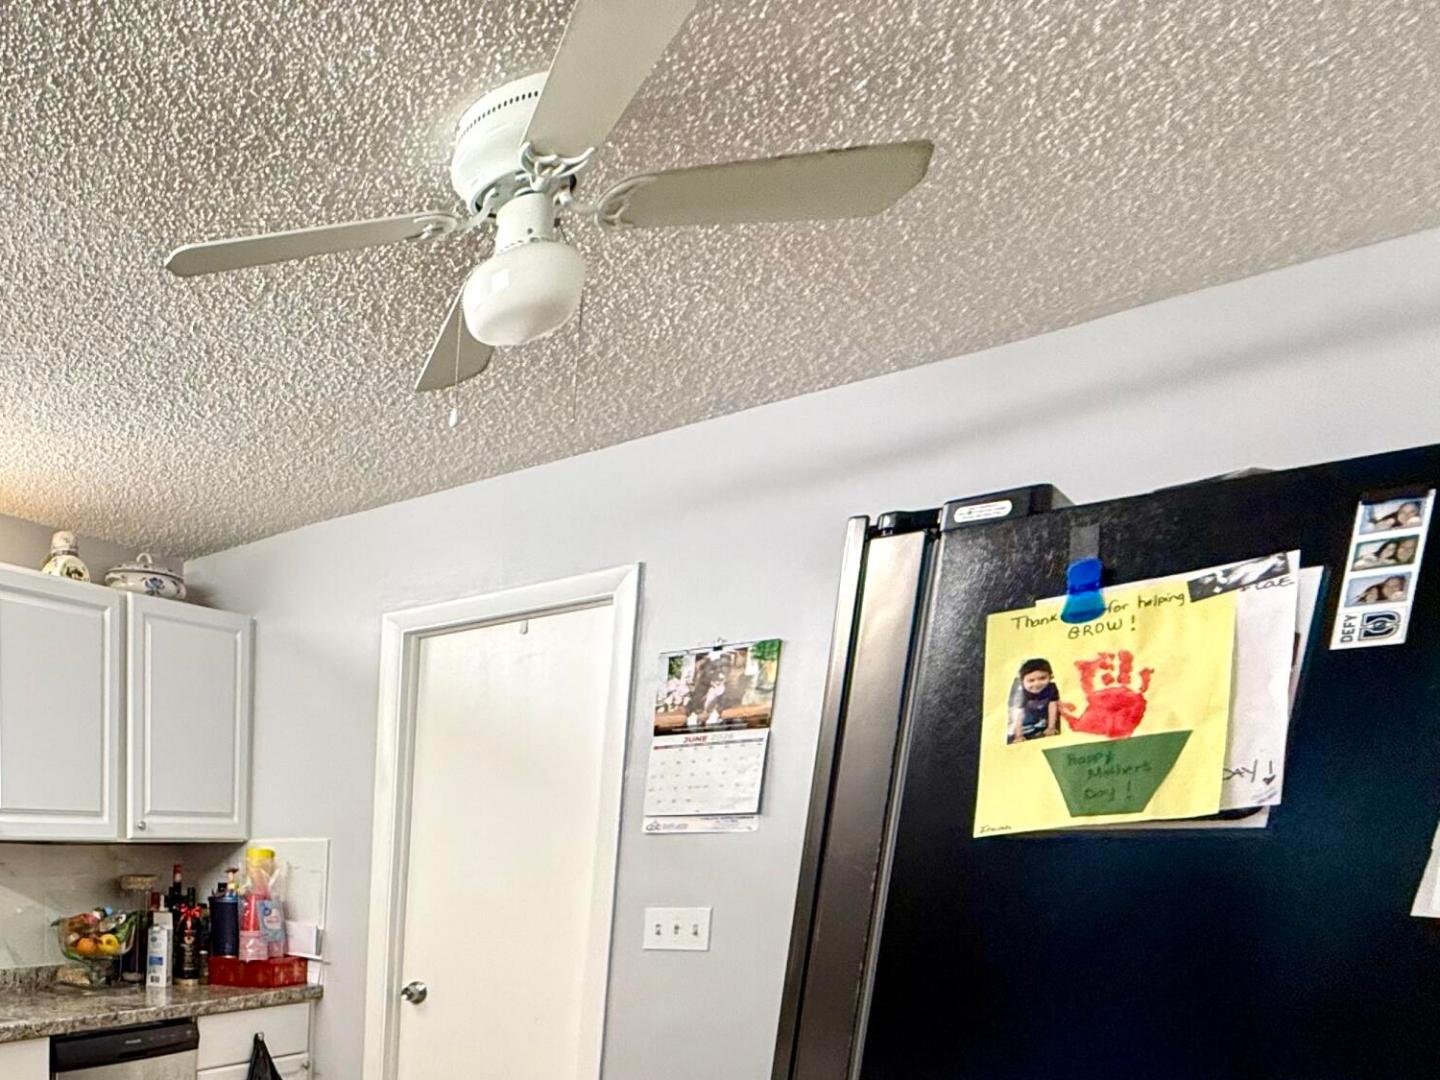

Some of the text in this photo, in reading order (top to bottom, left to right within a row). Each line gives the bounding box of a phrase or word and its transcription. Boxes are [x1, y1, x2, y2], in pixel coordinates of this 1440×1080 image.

[1012, 592, 1186, 630] Thank for helping
[1340, 615, 1357, 643] DEFY
